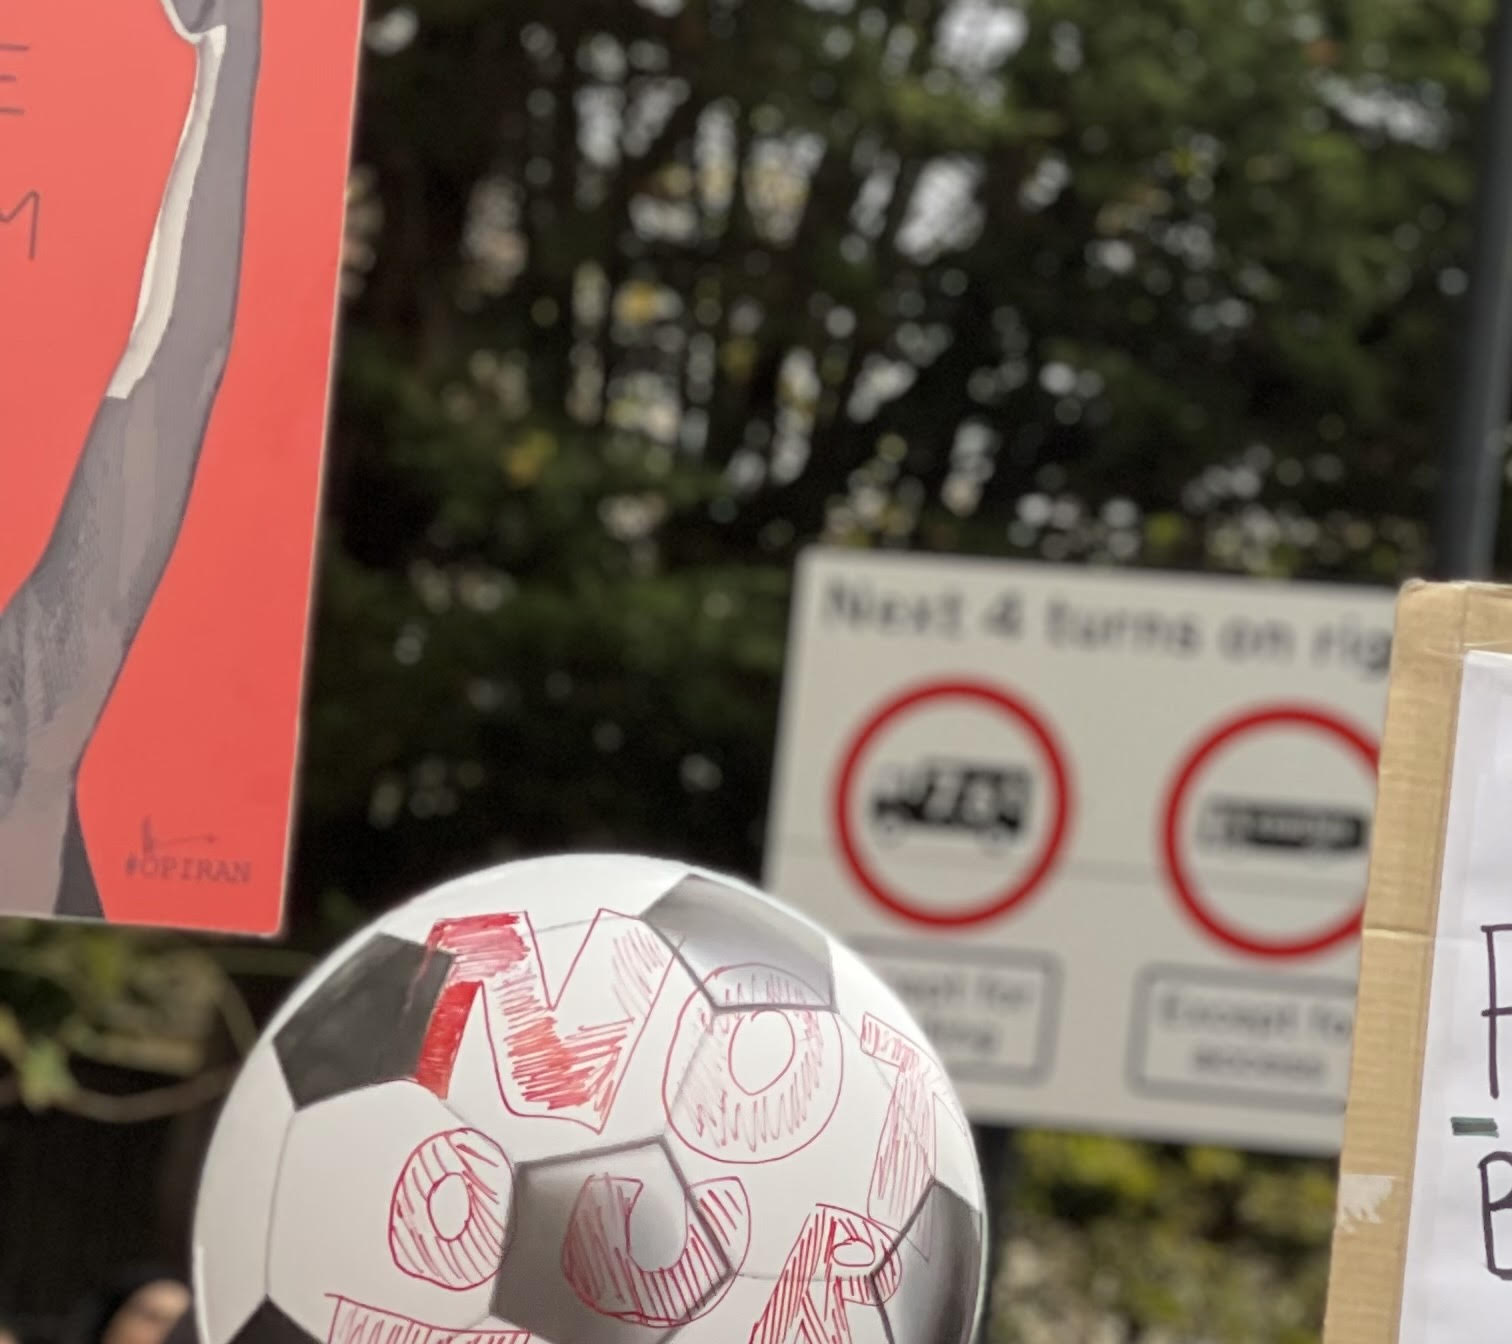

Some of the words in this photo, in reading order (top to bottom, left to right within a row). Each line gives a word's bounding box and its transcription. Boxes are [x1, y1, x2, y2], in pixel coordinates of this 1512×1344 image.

[1044, 599, 1200, 652] turns
[1219, 614, 1298, 655] on
[1311, 614, 1394, 680] rig
